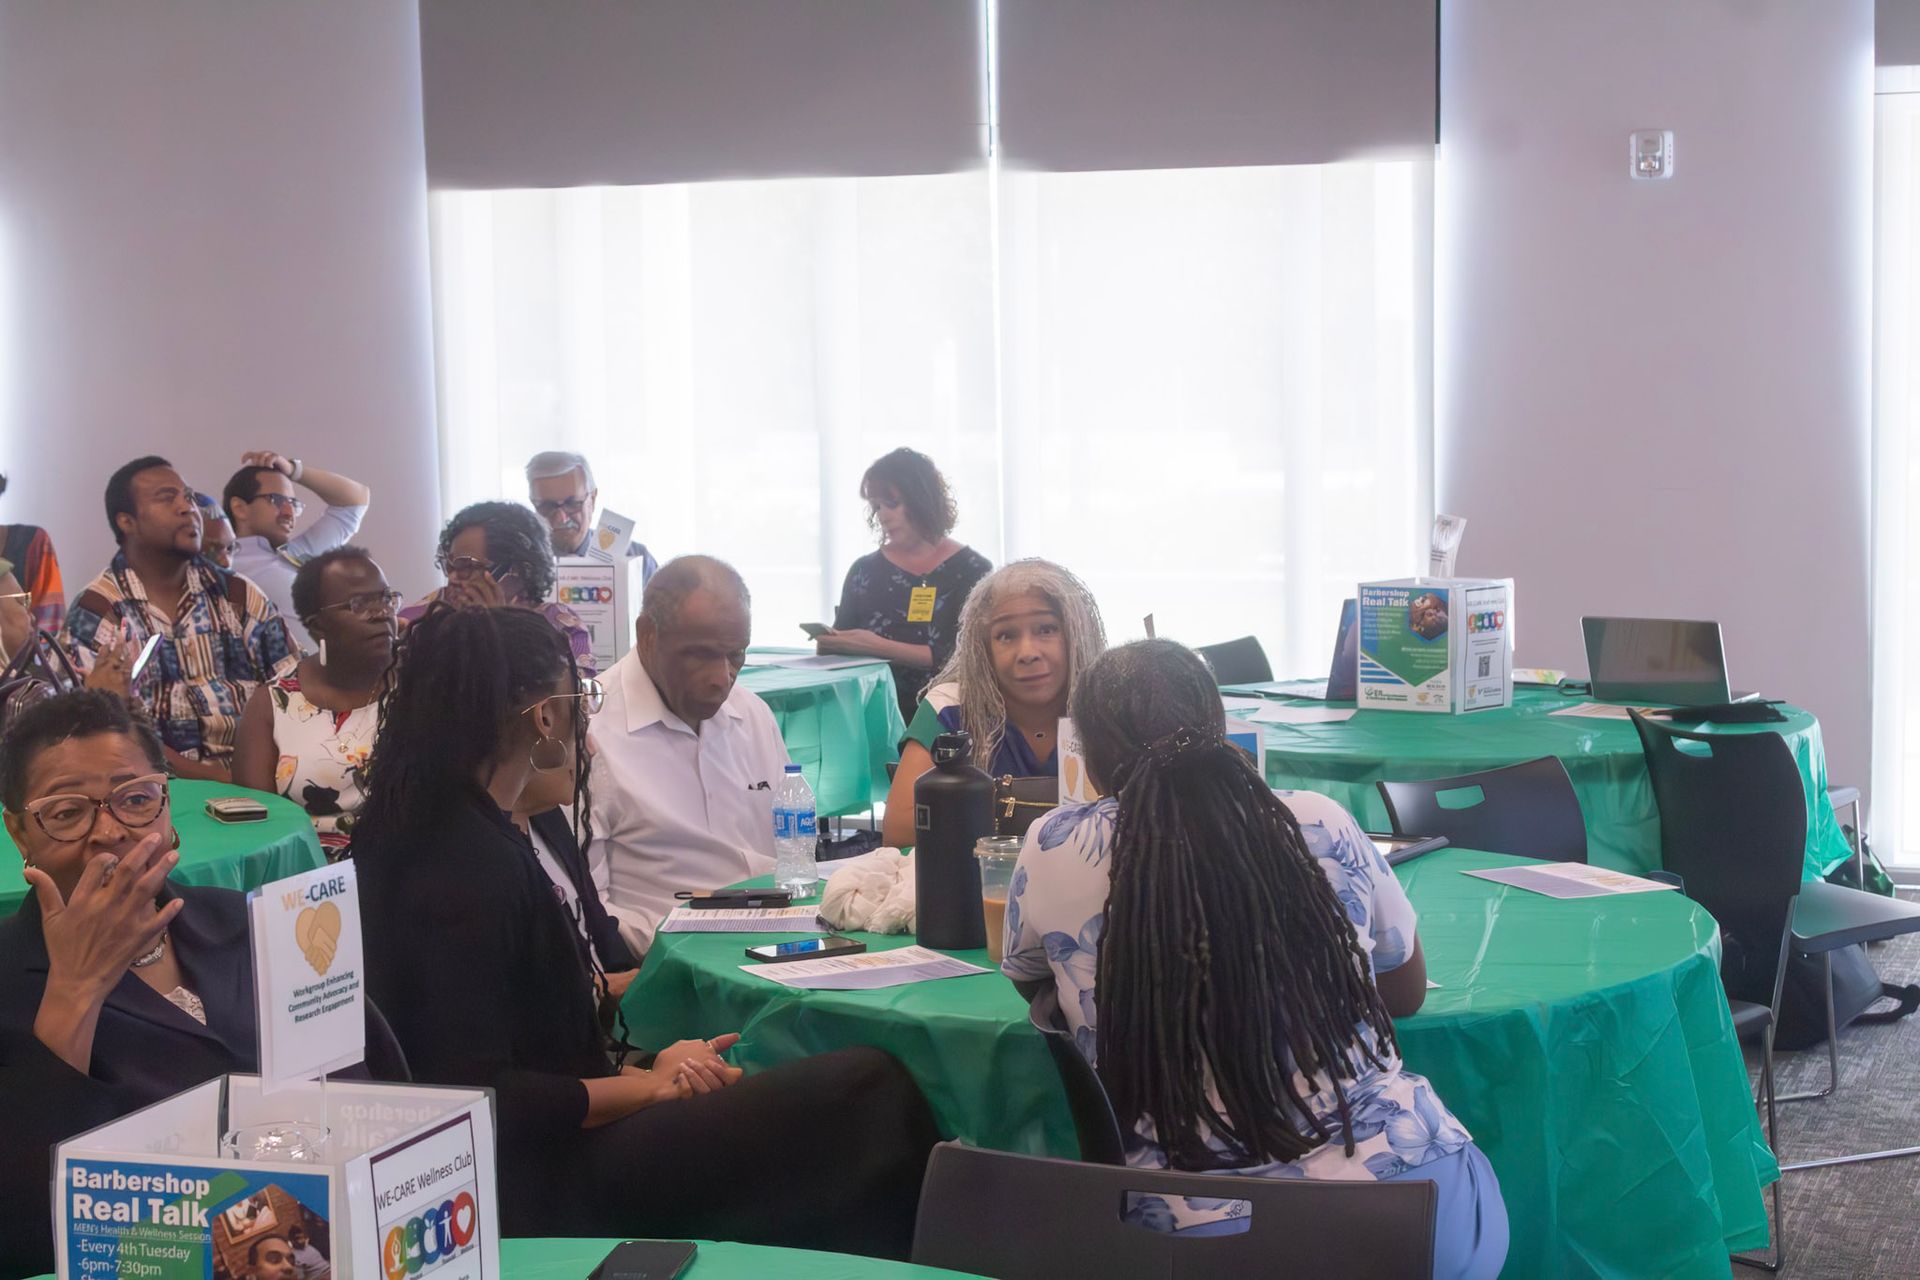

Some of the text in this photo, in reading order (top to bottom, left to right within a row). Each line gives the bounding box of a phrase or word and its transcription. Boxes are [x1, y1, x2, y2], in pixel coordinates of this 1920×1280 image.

[1362, 588, 1410, 597] Barbershop
[1362, 597, 1409, 607] Real Talk
[281, 876, 346, 912] WE-CARE
[288, 979, 360, 1013] Community Advocacy and
[293, 970, 354, 998] Workgroup Enhancing
[294, 994, 355, 1024] Research Engagement
[72, 1167, 210, 1199] Barbershop
[377, 1151, 473, 1211] WE-CARE Wellness Club
[73, 1193, 209, 1228] Real Talk
[100, 1224, 130, 1236] Health
[130, 1226, 138, 1236] &
[139, 1227, 177, 1239] Wellness
[116, 1242, 137, 1256] 4th
[137, 1243, 191, 1263] Tuesday
